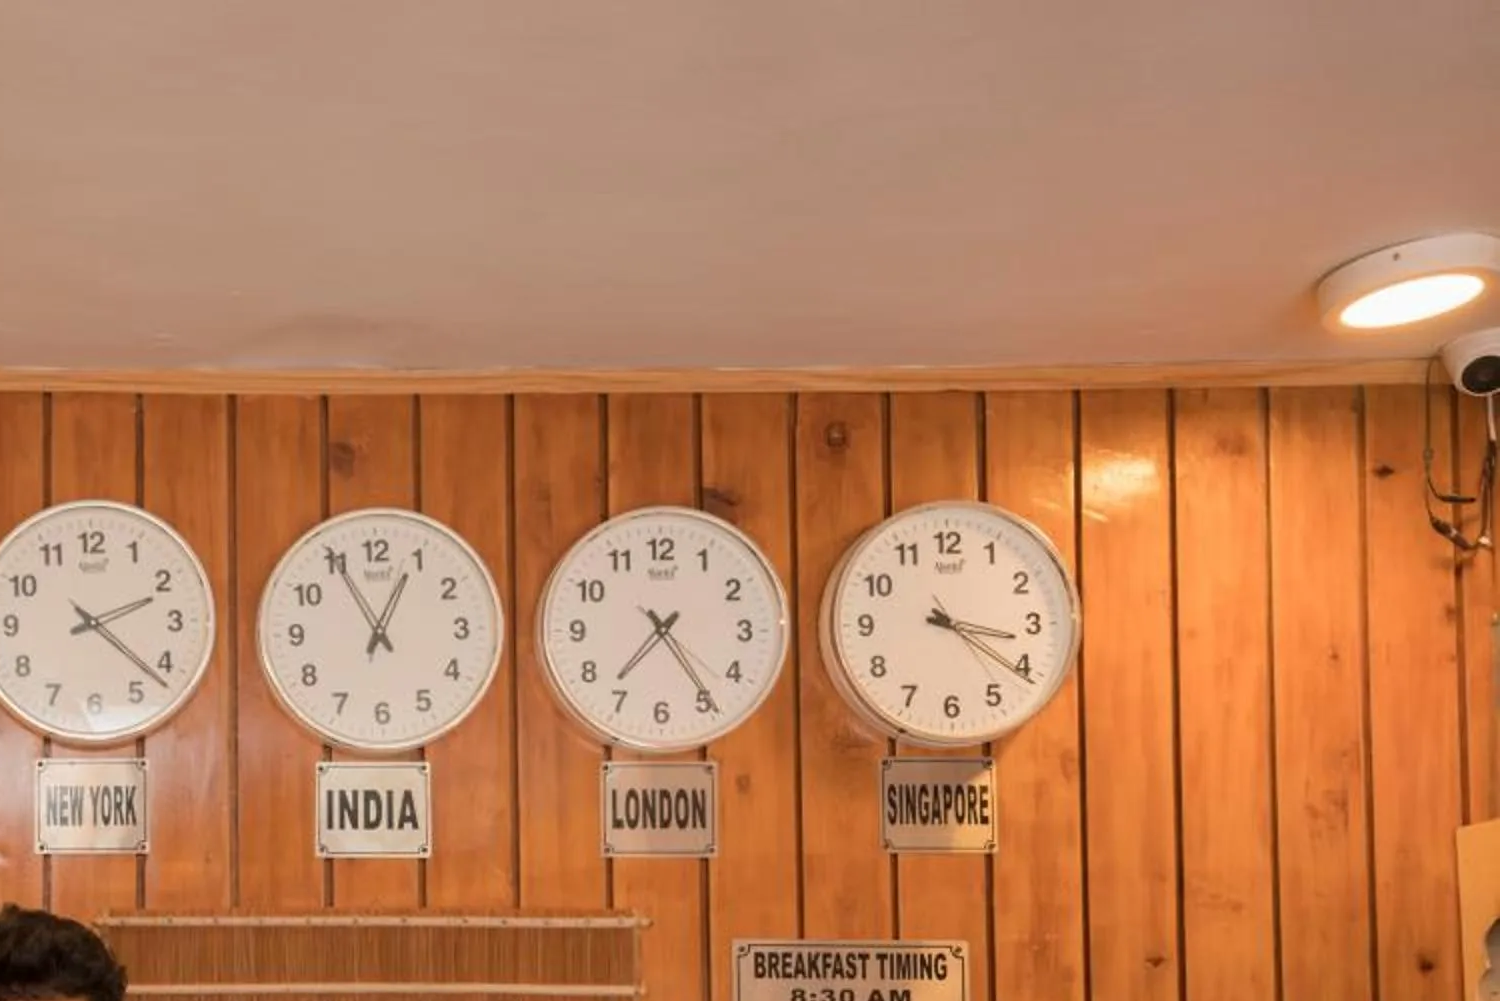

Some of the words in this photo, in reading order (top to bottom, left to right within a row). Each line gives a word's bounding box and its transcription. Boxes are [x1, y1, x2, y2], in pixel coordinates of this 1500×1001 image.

[78, 531, 105, 553] 12
[127, 542, 139, 563] 1
[361, 540, 389, 562] 12
[646, 539, 674, 561] 12
[933, 532, 961, 554] 12
[40, 543, 64, 565] 11
[412, 550, 424, 570] 1
[609, 550, 632, 571] 11
[697, 550, 709, 570] 1
[895, 544, 919, 565] 11
[984, 542, 995, 565] 1
[9, 575, 37, 597] 10
[155, 570, 171, 591] 2
[441, 579, 458, 599] 2
[577, 580, 605, 602] 10
[725, 580, 742, 601] 2
[865, 575, 892, 597] 10
[1013, 572, 1030, 594] 2
[294, 584, 322, 606] 10
[3, 615, 20, 637] 9
[167, 611, 183, 632] 3
[453, 618, 470, 639] 3
[569, 620, 586, 641] 9
[737, 620, 753, 642] 3
[857, 615, 875, 636] 9
[1025, 613, 1042, 635] 3
[288, 624, 305, 646] 9
[15, 655, 31, 676] 8
[157, 652, 173, 672] 4
[444, 659, 461, 680] 4
[581, 661, 598, 683] 8
[725, 661, 742, 682] 4
[870, 655, 887, 678] 8
[1015, 655, 1031, 677] 4
[301, 664, 317, 686] 8
[45, 684, 62, 705] 7
[128, 682, 144, 703] 5
[331, 693, 348, 714] 7
[416, 691, 432, 712] 5
[612, 691, 628, 712] 7
[696, 690, 712, 713] 5
[901, 685, 918, 707] 7
[985, 684, 1002, 707] 5
[86, 693, 103, 715] 6
[374, 702, 391, 724] 6
[653, 701, 670, 723] 6
[944, 695, 960, 718] 6
[46, 785, 84, 827] NEW
[88, 785, 137, 826] YORK
[326, 789, 419, 831] INDIA
[611, 788, 707, 830] LONDON
[887, 784, 990, 826] SINGAPORE
[753, 951, 870, 980] BREAKFAST
[876, 953, 947, 981] TIMING
